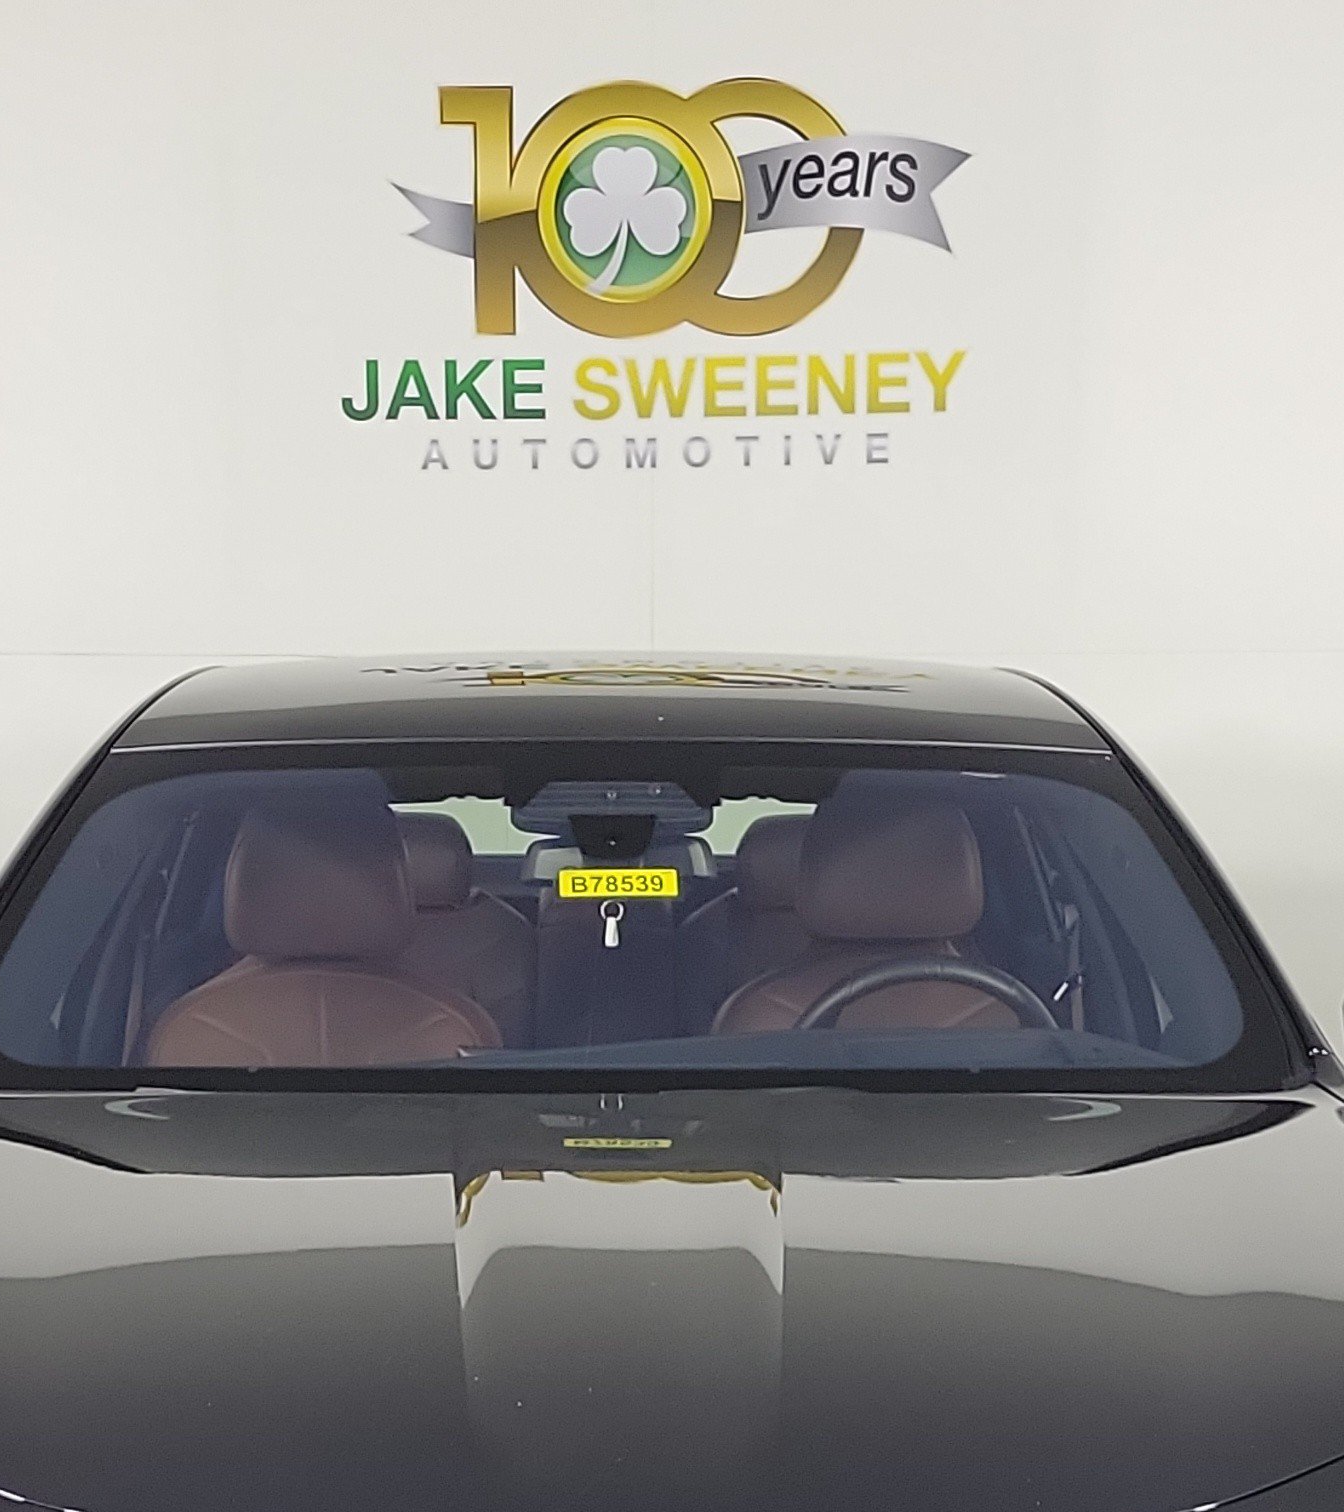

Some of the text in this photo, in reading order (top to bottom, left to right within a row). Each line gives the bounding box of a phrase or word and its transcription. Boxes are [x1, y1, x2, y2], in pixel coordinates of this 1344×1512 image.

[437, 76, 918, 338] 100 years
[341, 349, 967, 421] JAKE SWEENEY
[420, 432, 891, 471] AUTOMOTIVE
[571, 875, 664, 893] B78539
